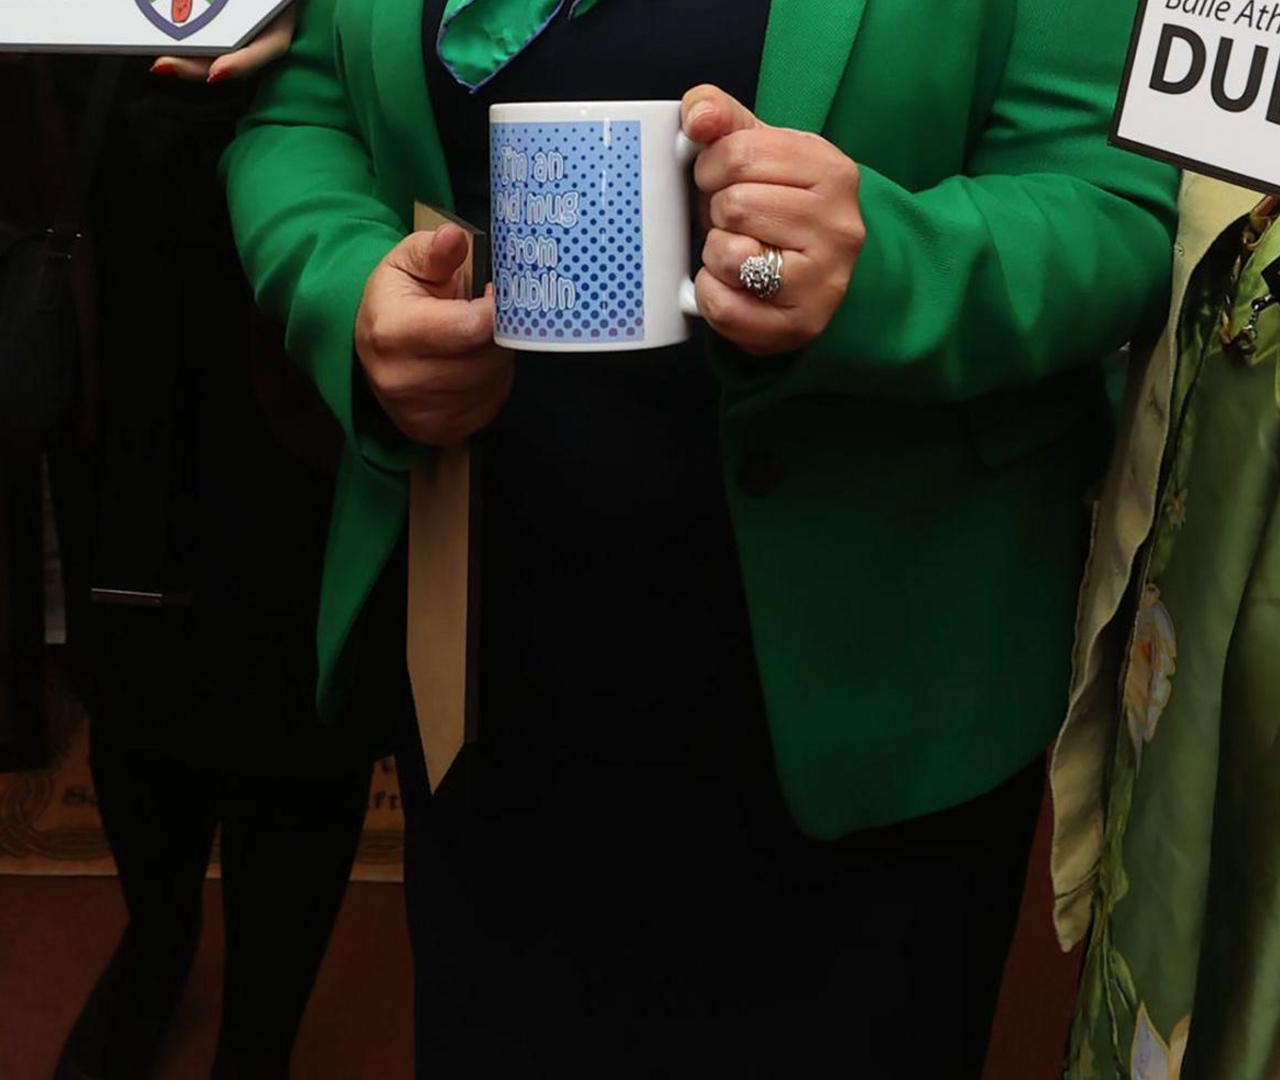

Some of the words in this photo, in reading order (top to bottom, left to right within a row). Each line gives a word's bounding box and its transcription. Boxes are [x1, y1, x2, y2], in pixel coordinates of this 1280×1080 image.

[533, 150, 564, 183] an
[526, 190, 580, 228] mug
[507, 232, 558, 268] from
[499, 268, 576, 312] Dublin
